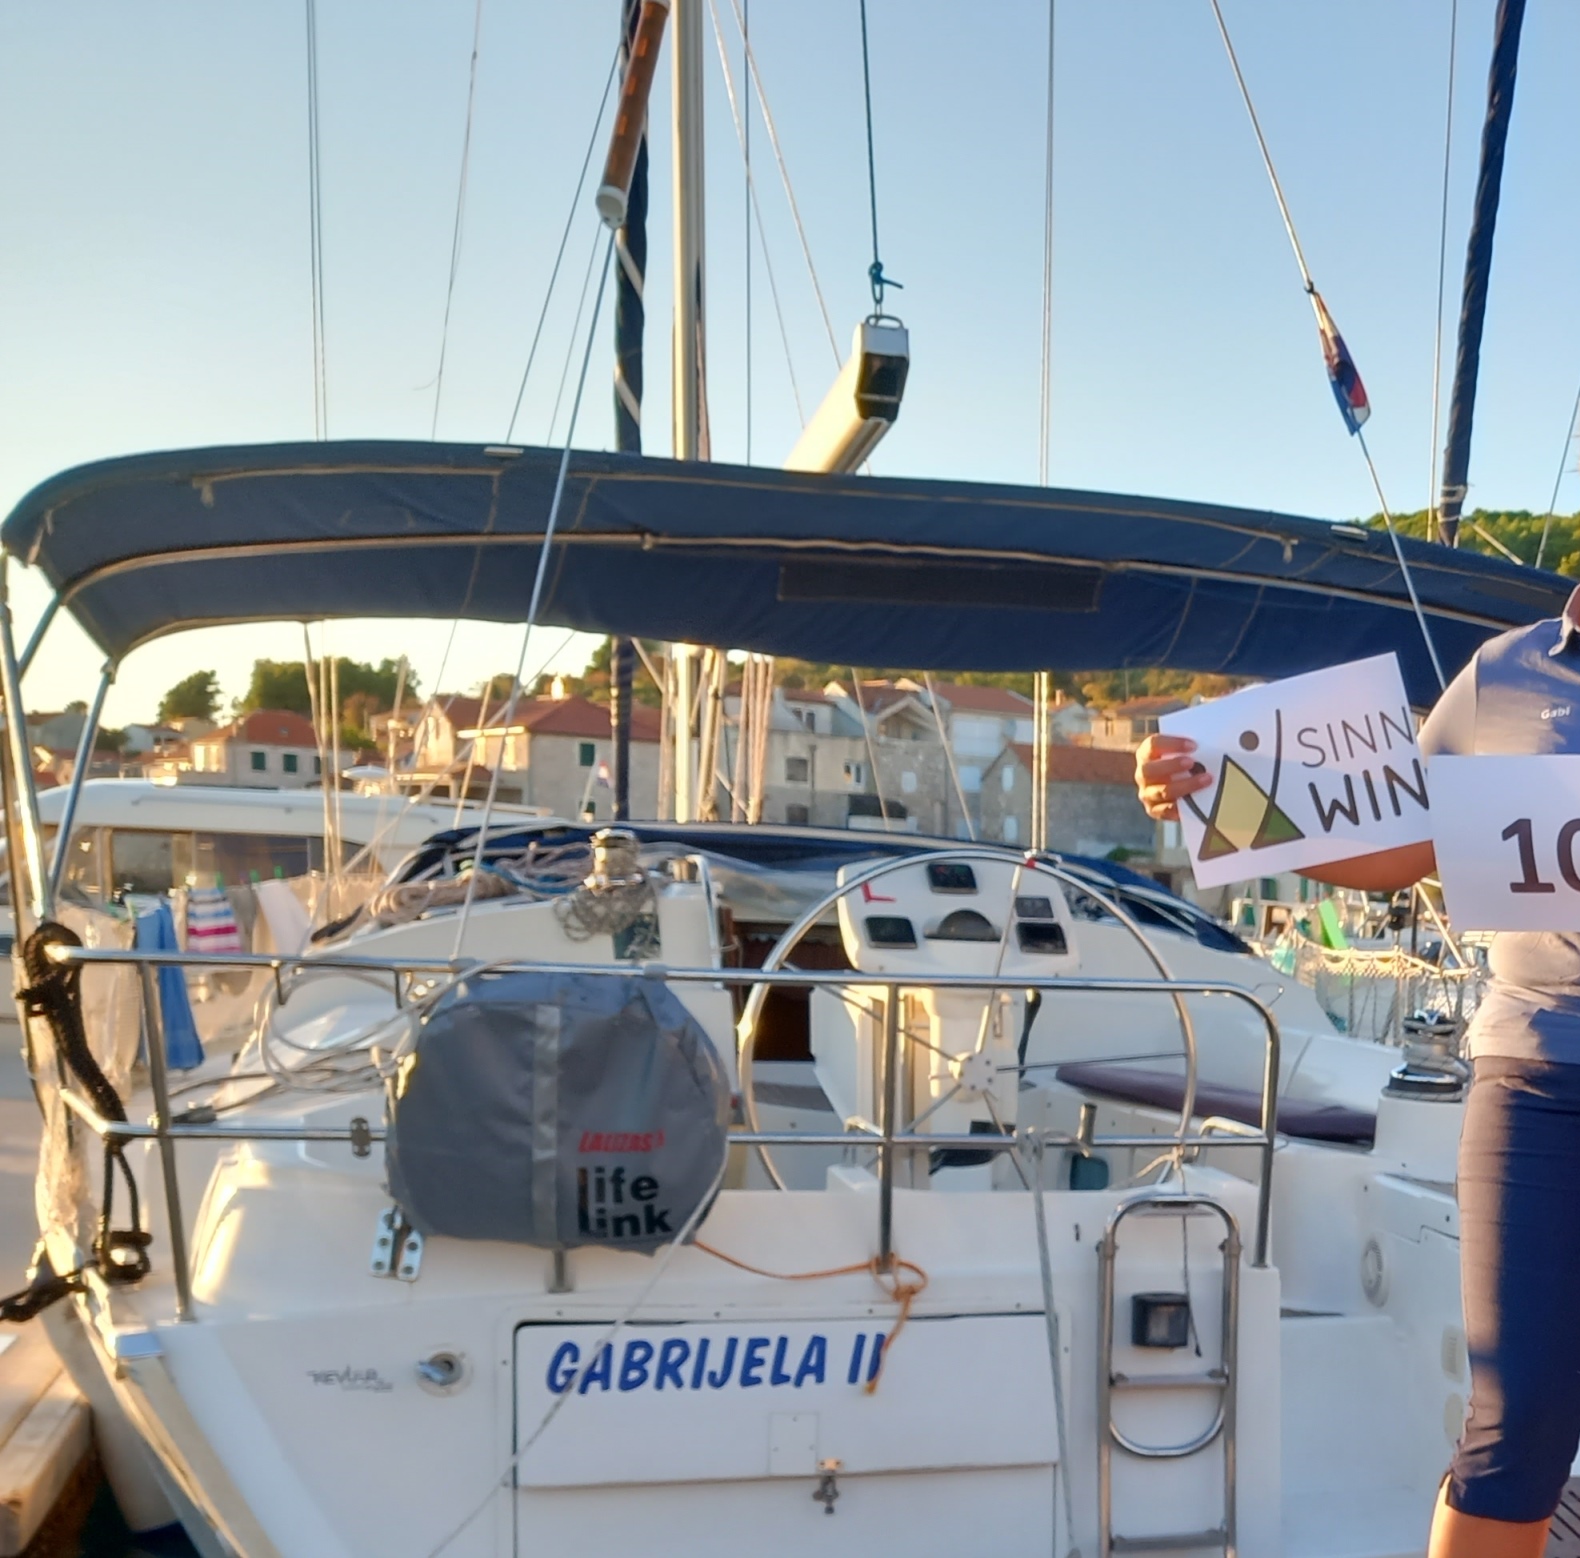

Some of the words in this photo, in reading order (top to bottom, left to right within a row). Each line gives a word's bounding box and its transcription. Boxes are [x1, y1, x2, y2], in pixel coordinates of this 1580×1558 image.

[1296, 706, 1413, 768] SINN
[1540, 705, 1571, 720] Gabi
[1307, 757, 1431, 832] WIN
[577, 1165, 660, 1205] life
[577, 1203, 673, 1237] link
[545, 1334, 828, 1395] GABRIJELA
[846, 1332, 887, 1386] II
